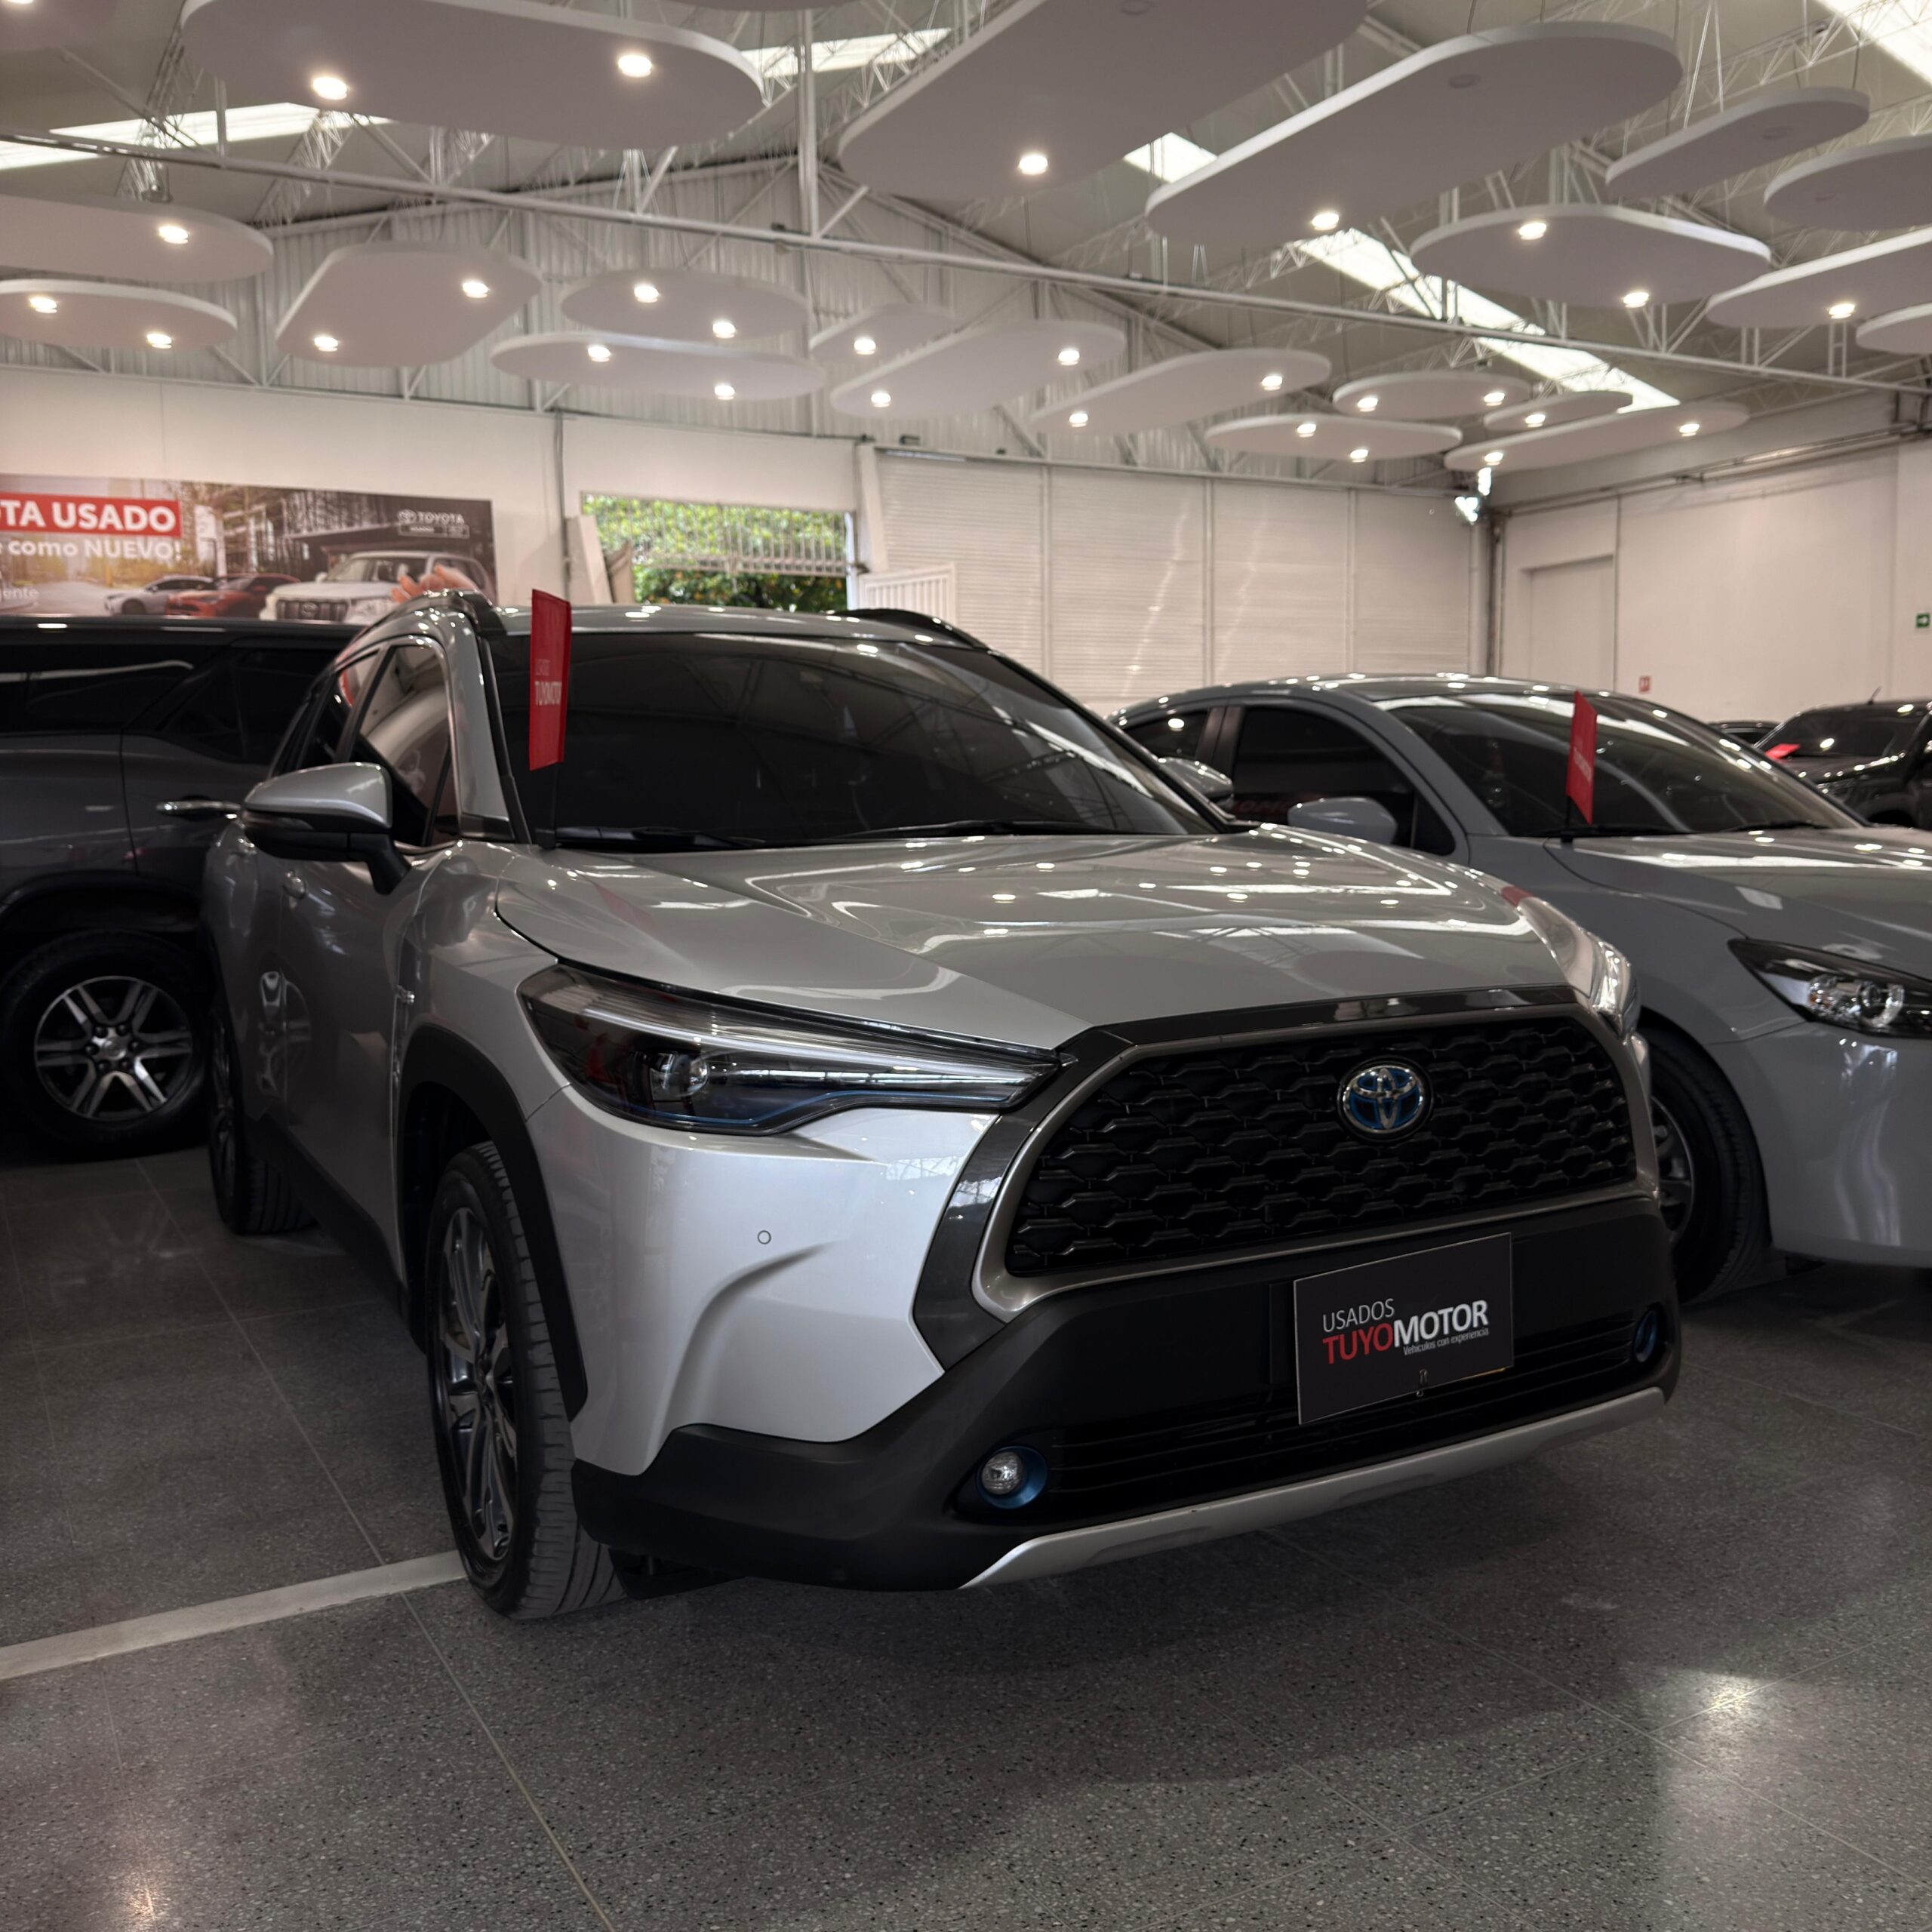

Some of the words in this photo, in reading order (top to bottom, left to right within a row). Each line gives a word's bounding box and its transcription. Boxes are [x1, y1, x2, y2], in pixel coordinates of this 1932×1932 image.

[0, 500, 46, 527] TA
[52, 502, 176, 532] USADO
[417, 511, 465, 525] TOYOTA
[8, 540, 77, 556] como
[84, 539, 181, 561] NUEVO!
[1323, 1298, 1395, 1333] USADOS
[1322, 1300, 1488, 1364] TUYOMOTOR
[1437, 1337, 1450, 1348] con
[1451, 1327, 1490, 1344] experiencia
